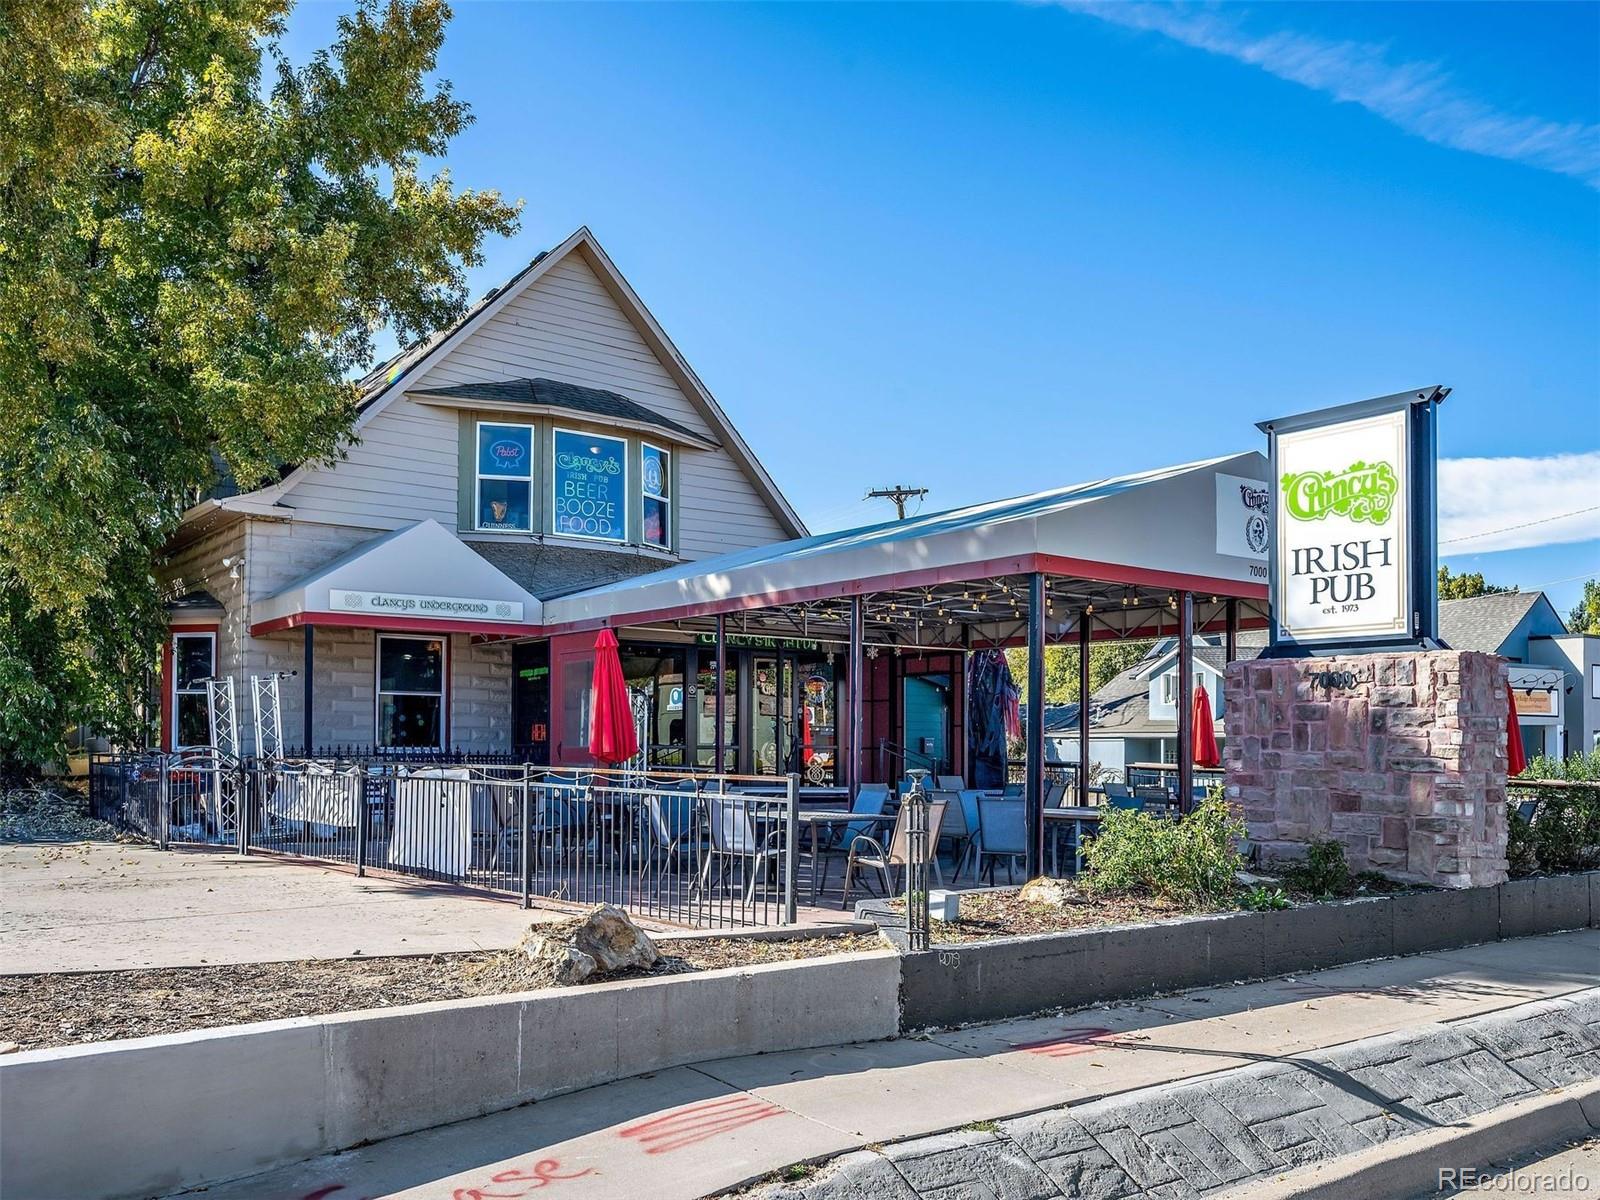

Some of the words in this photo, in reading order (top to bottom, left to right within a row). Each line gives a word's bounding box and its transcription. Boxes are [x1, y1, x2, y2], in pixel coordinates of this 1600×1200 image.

[495, 445, 520, 457] Pabst
[567, 471, 587, 481] IRISH
[564, 480, 608, 501] BEER
[556, 497, 616, 519] BOOZE
[559, 515, 612, 535] FOOD
[1291, 537, 1393, 576] IRISH
[1249, 565, 1268, 578] 7000
[1309, 572, 1376, 605] PUB
[1322, 605, 1338, 615] est.
[1341, 603, 1359, 613] 1973
